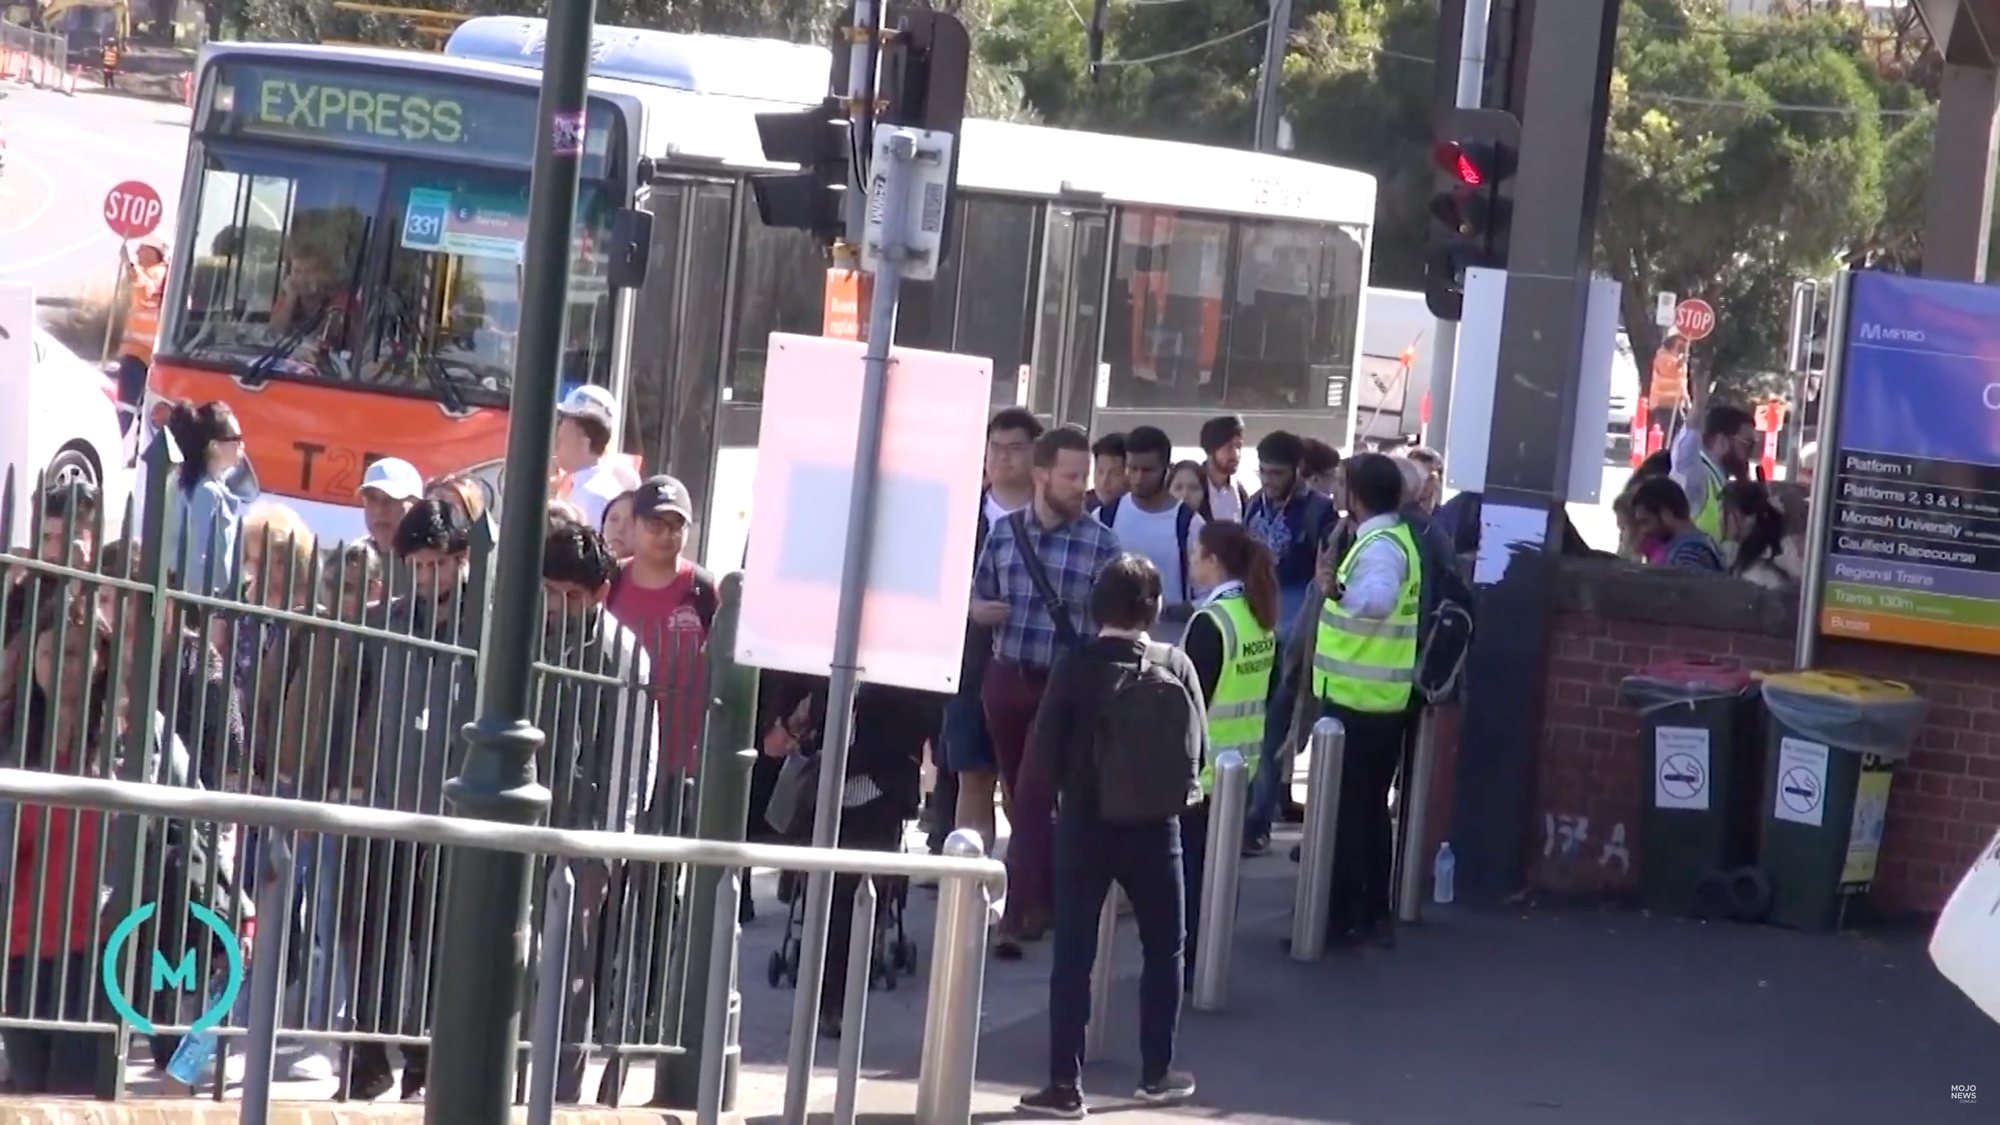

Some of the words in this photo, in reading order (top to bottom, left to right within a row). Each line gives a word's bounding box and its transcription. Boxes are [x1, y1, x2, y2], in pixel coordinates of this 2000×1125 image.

[260, 80, 463, 142] EXPRESS
[106, 191, 160, 227] STOP
[409, 215, 439, 236] 331
[1676, 307, 1711, 331] STOP
[1882, 328, 1925, 341] METRO
[1846, 456, 1901, 474] Platform
[1906, 464, 1912, 475] 1
[1843, 482, 1905, 502] Platforms
[1924, 493, 1934, 505] 3
[1937, 495, 1947, 507] &
[1951, 496, 1960, 507] 4
[1841, 510, 1894, 527] Monash
[1897, 516, 1962, 538] University
[1838, 536, 1895, 554] Caulfield
[1898, 543, 1976, 563] Racecourse
[1835, 563, 1892, 581] Regional
[1896, 570, 1934, 586] Trains
[1834, 589, 1872, 605] Trams
[1879, 595, 1914, 610] 130m
[1830, 616, 1870, 632] Buses
